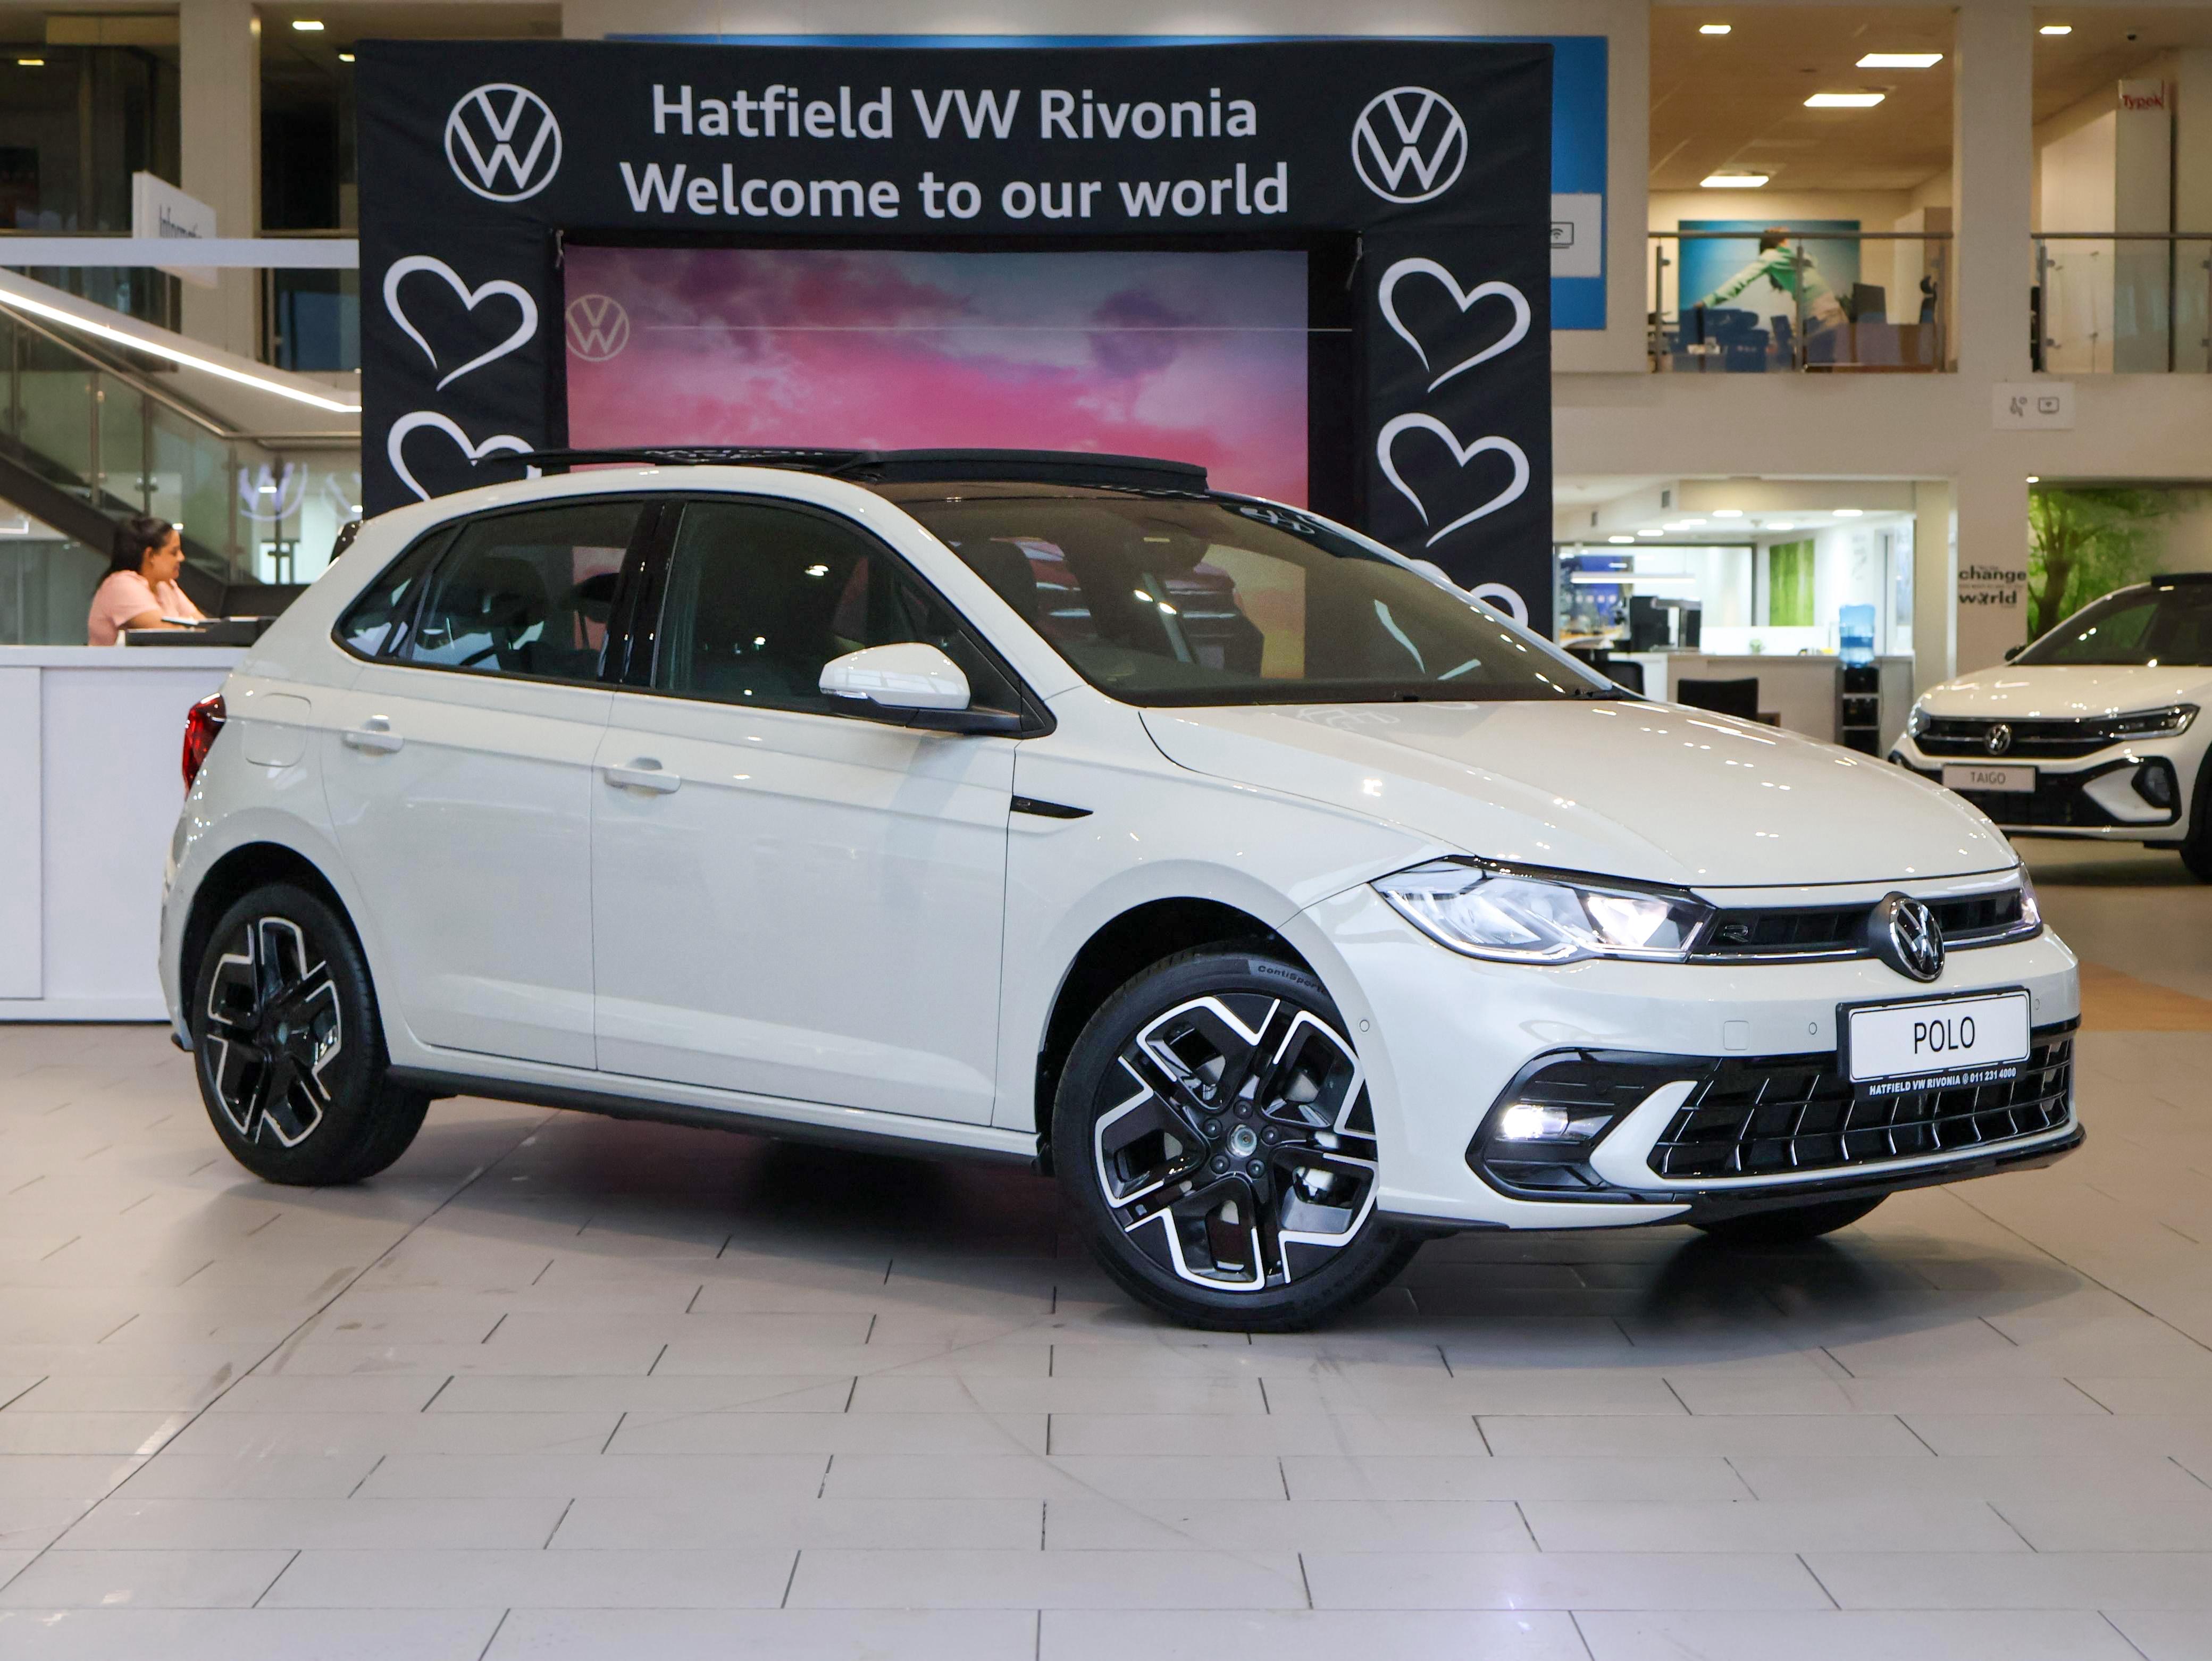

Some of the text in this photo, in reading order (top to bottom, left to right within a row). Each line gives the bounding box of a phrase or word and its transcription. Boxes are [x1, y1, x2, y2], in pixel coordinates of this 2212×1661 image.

[653, 85, 1256, 139] Hatfield VW Rivonia
[620, 162, 1288, 218] Welcome to our world
[1959, 565, 2027, 583] change
[1971, 772, 2006, 784] TAIGO
[1914, 1016, 1975, 1054] POLO
[1869, 1081, 1911, 1095] HATFIELD
[1913, 1079, 1925, 1090] VW
[1927, 1075, 1961, 1088] RIVONIA
[1970, 1072, 1983, 1083] 011
[1984, 1070, 1998, 1081] 231
[1999, 1067, 2016, 1078] 4000
